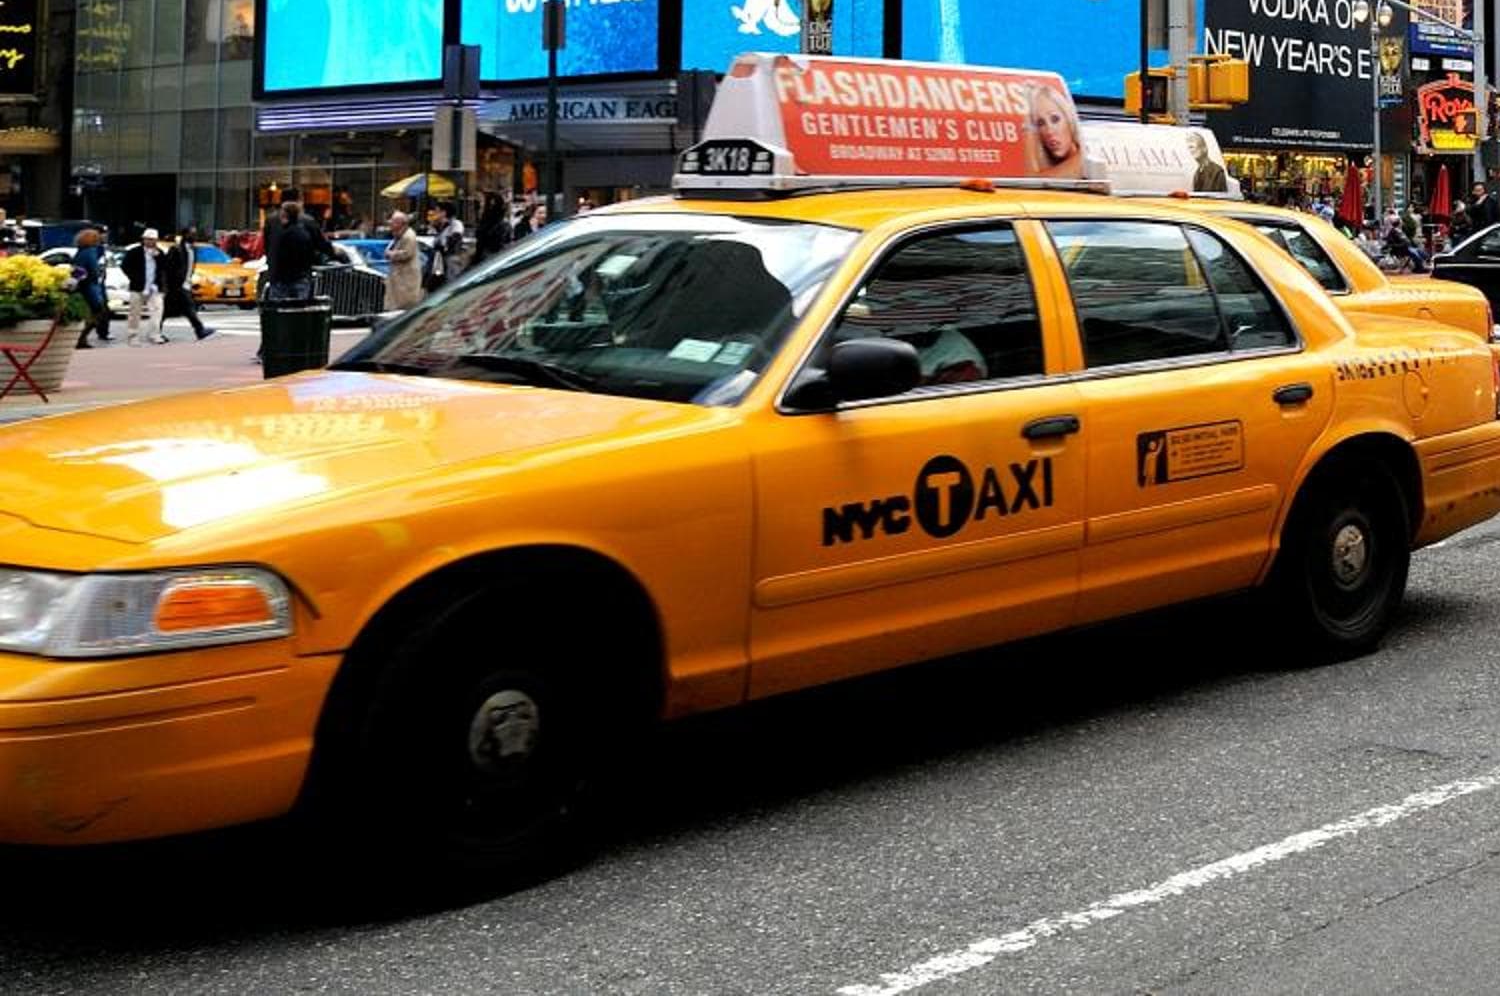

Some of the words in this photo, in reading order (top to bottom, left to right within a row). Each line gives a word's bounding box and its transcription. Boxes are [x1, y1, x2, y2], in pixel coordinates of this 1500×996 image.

[1204, 27, 1265, 68] NEW
[1271, 36, 1352, 79] YEAR'S
[774, 66, 1030, 116] FLASHDANCERS
[802, 110, 959, 142] GENTLEMEN'S
[965, 115, 1020, 145] CLUB
[703, 146, 750, 172] 3K18
[829, 142, 905, 161] BROADWAY
[907, 146, 922, 161] AT
[959, 149, 1001, 164] STREET
[821, 493, 911, 548] NYC
[916, 455, 1054, 535] TAXI
